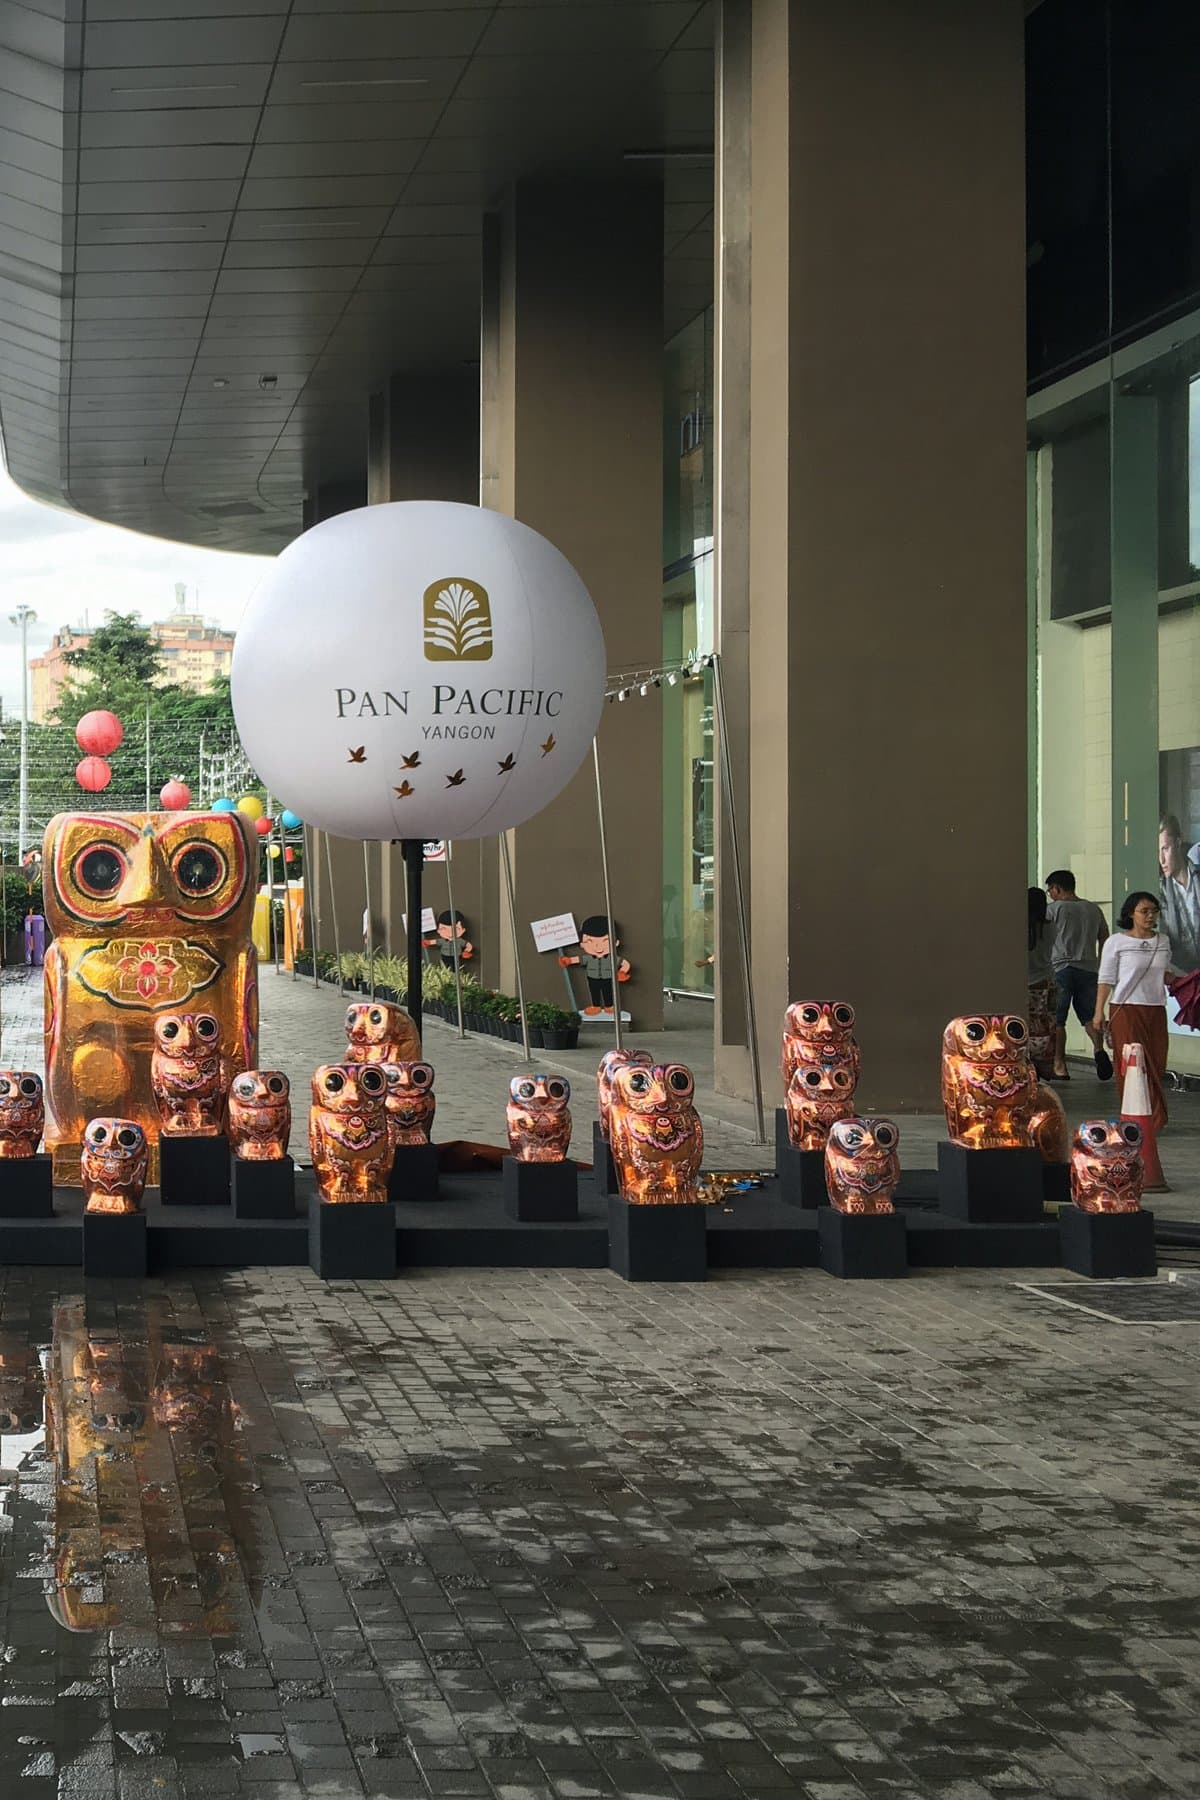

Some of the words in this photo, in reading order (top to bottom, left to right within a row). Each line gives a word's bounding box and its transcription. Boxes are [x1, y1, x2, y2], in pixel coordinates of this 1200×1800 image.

[334, 687, 410, 718] PAN
[431, 685, 564, 717] PACIFIC
[421, 725, 496, 740] YANGON
